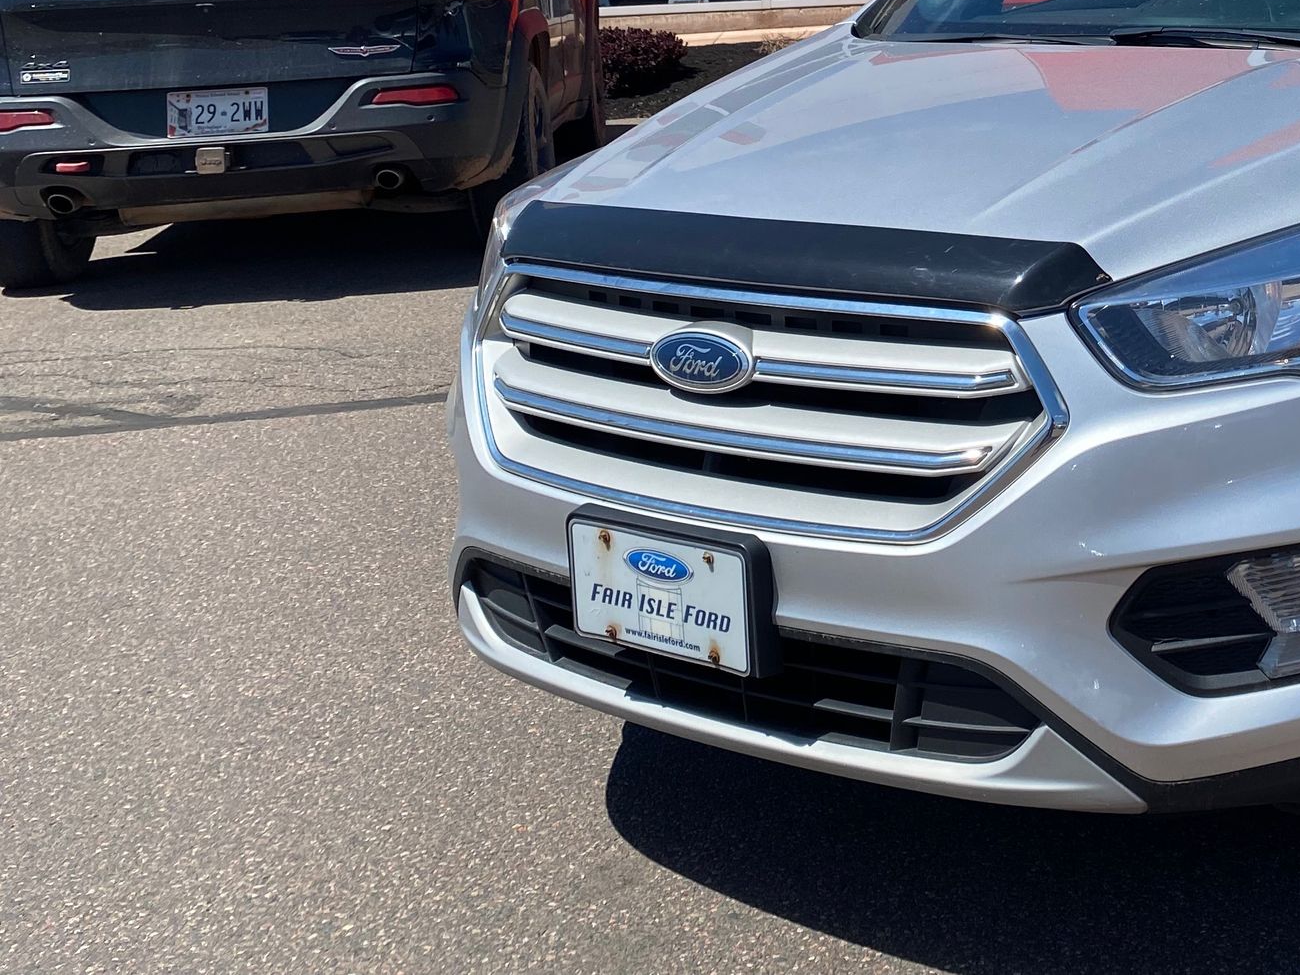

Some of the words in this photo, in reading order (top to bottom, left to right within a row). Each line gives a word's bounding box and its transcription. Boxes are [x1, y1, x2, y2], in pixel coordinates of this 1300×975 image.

[669, 343, 723, 378] Ford
[638, 552, 677, 578] Ford
[591, 583, 633, 609] FAIR
[639, 594, 677, 620] ISLE
[683, 605, 731, 633] FORD
[625, 627, 700, 652] www.fairisleford.com
